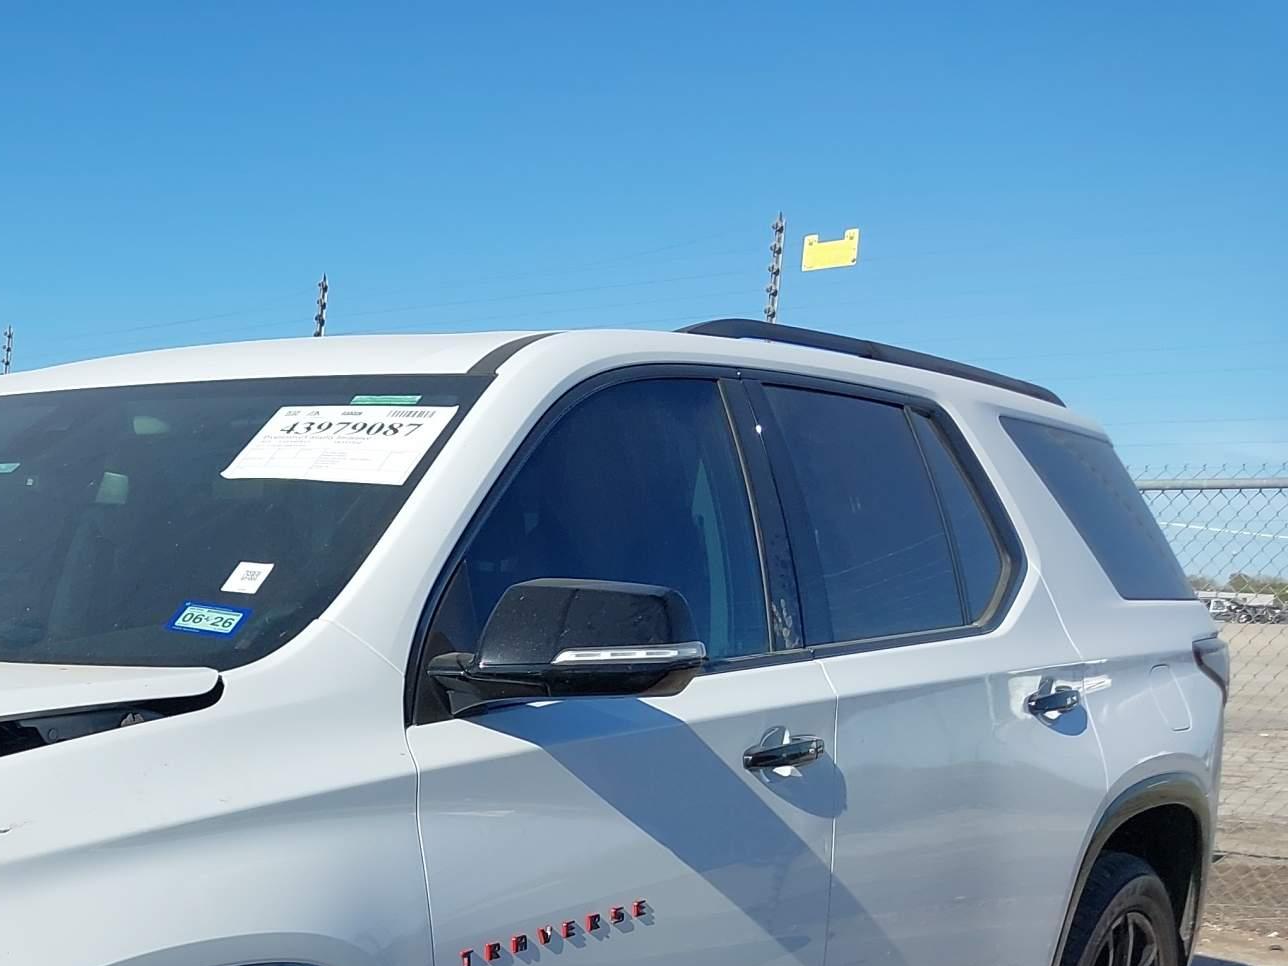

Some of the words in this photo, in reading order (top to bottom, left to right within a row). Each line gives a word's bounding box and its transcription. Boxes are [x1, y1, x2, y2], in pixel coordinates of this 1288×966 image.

[280, 421, 423, 437] 43979087
[181, 612, 206, 624] 06
[209, 616, 236, 628] 26
